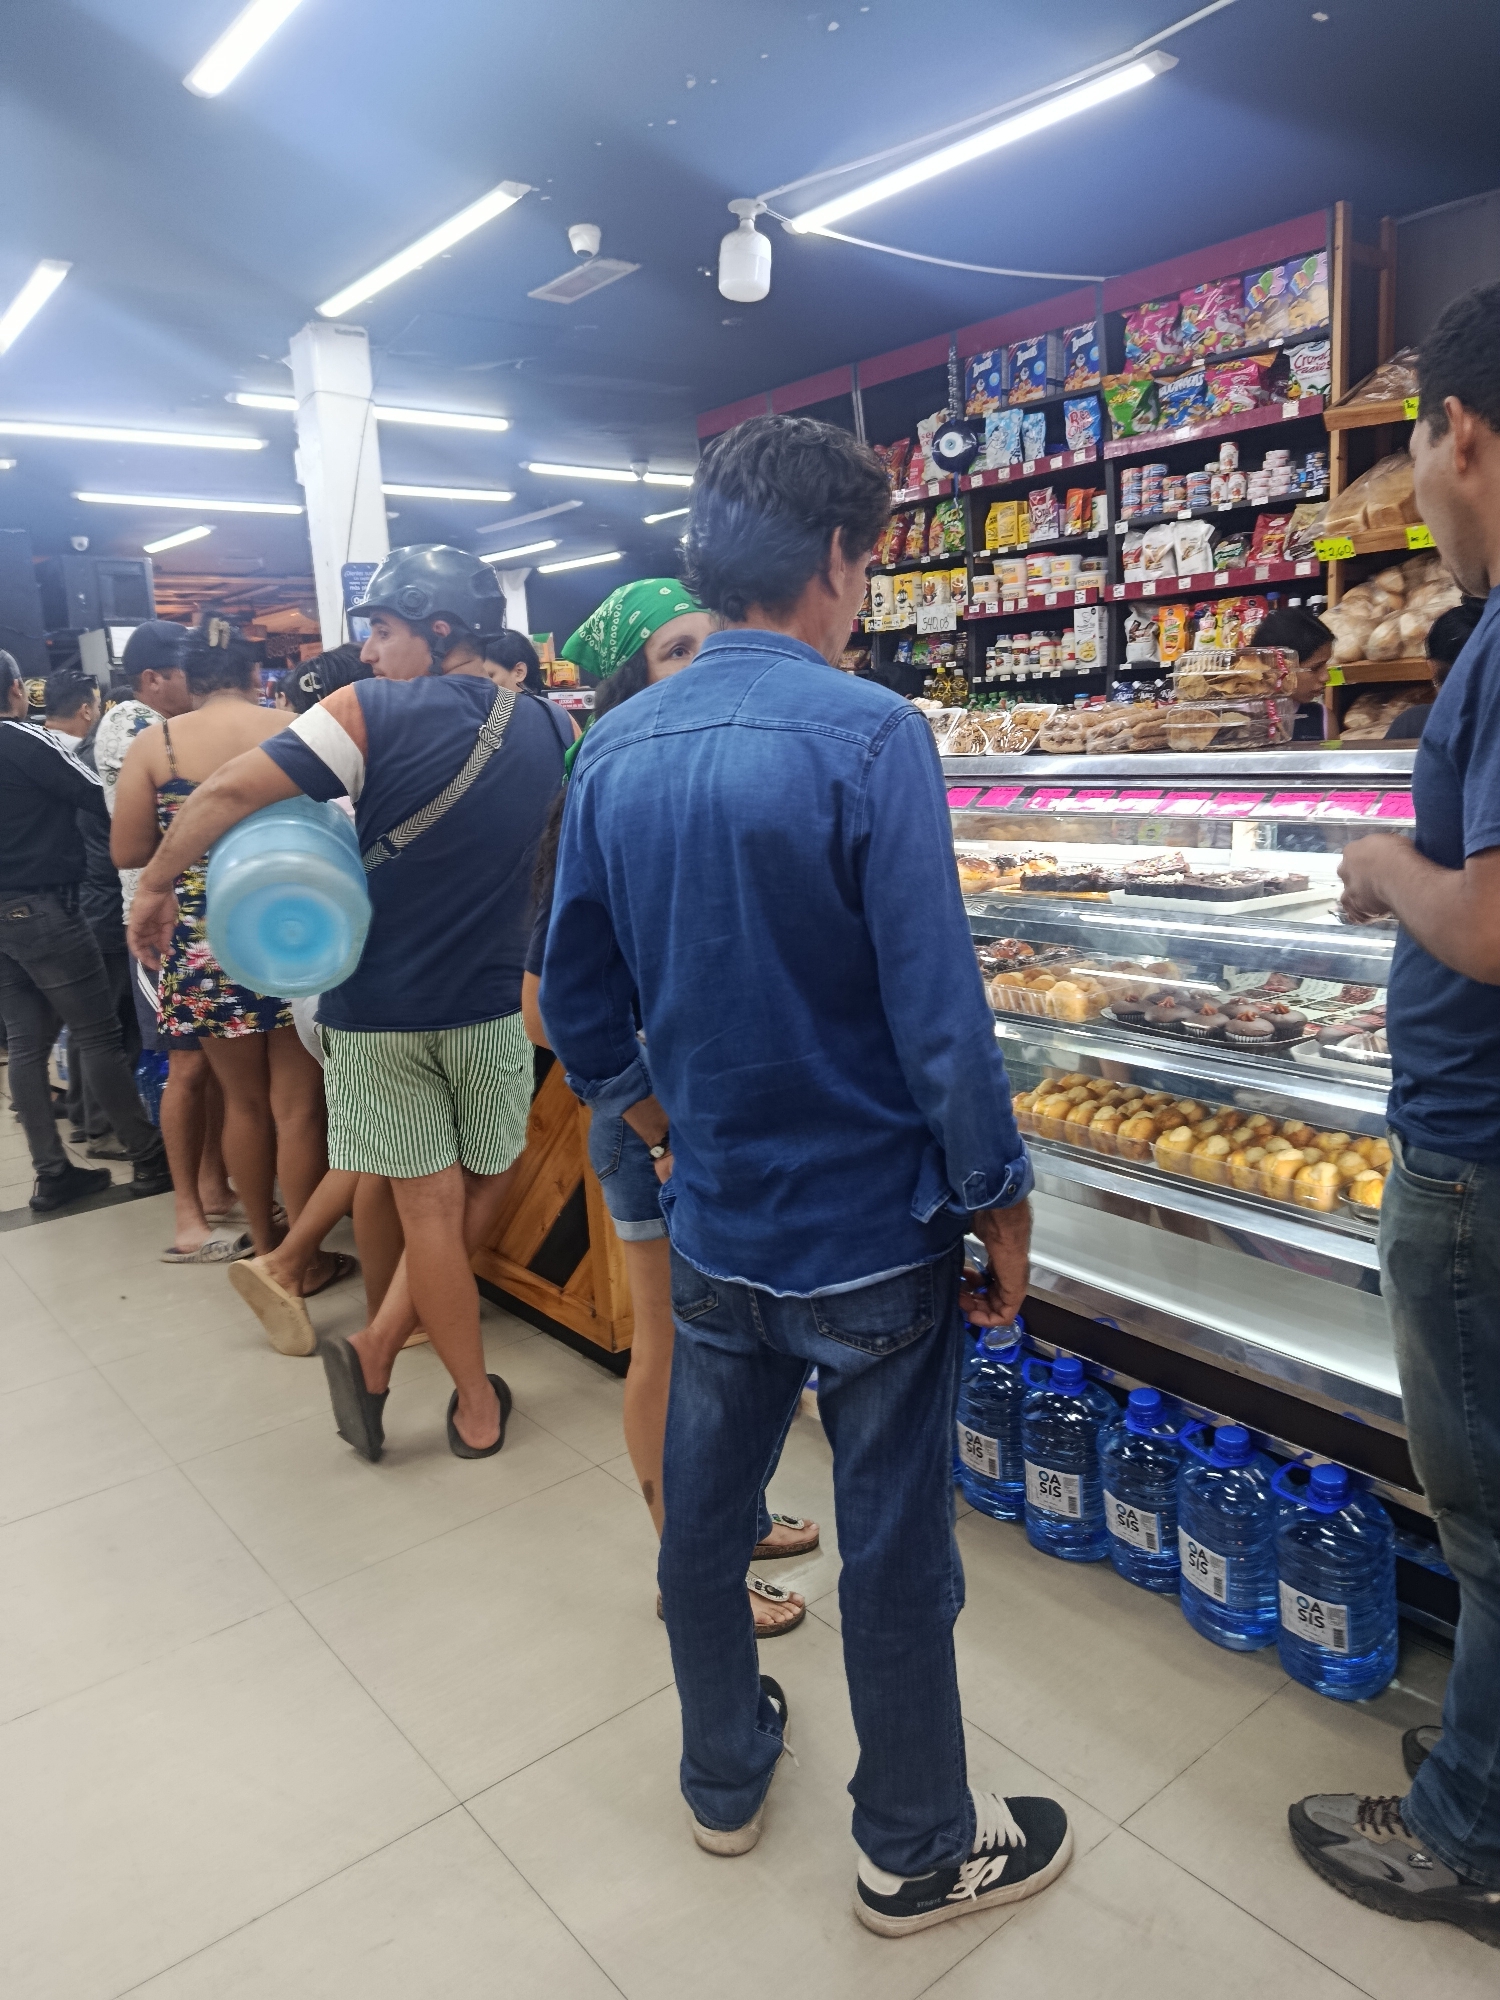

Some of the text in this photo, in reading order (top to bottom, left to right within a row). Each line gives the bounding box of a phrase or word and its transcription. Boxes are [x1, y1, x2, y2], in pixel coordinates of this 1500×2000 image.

[965, 1430, 983, 1448] OA
[966, 1441, 984, 1459] SIS
[1038, 1470, 1062, 1487] OA
[1039, 1481, 1062, 1498] SIS
[1116, 1503, 1138, 1522] OA
[1117, 1513, 1140, 1532] SIS
[1188, 1541, 1209, 1564] OA
[1189, 1552, 1208, 1575] SIS
[1296, 1595, 1324, 1617] OA
[1297, 1607, 1325, 1629] SIS
